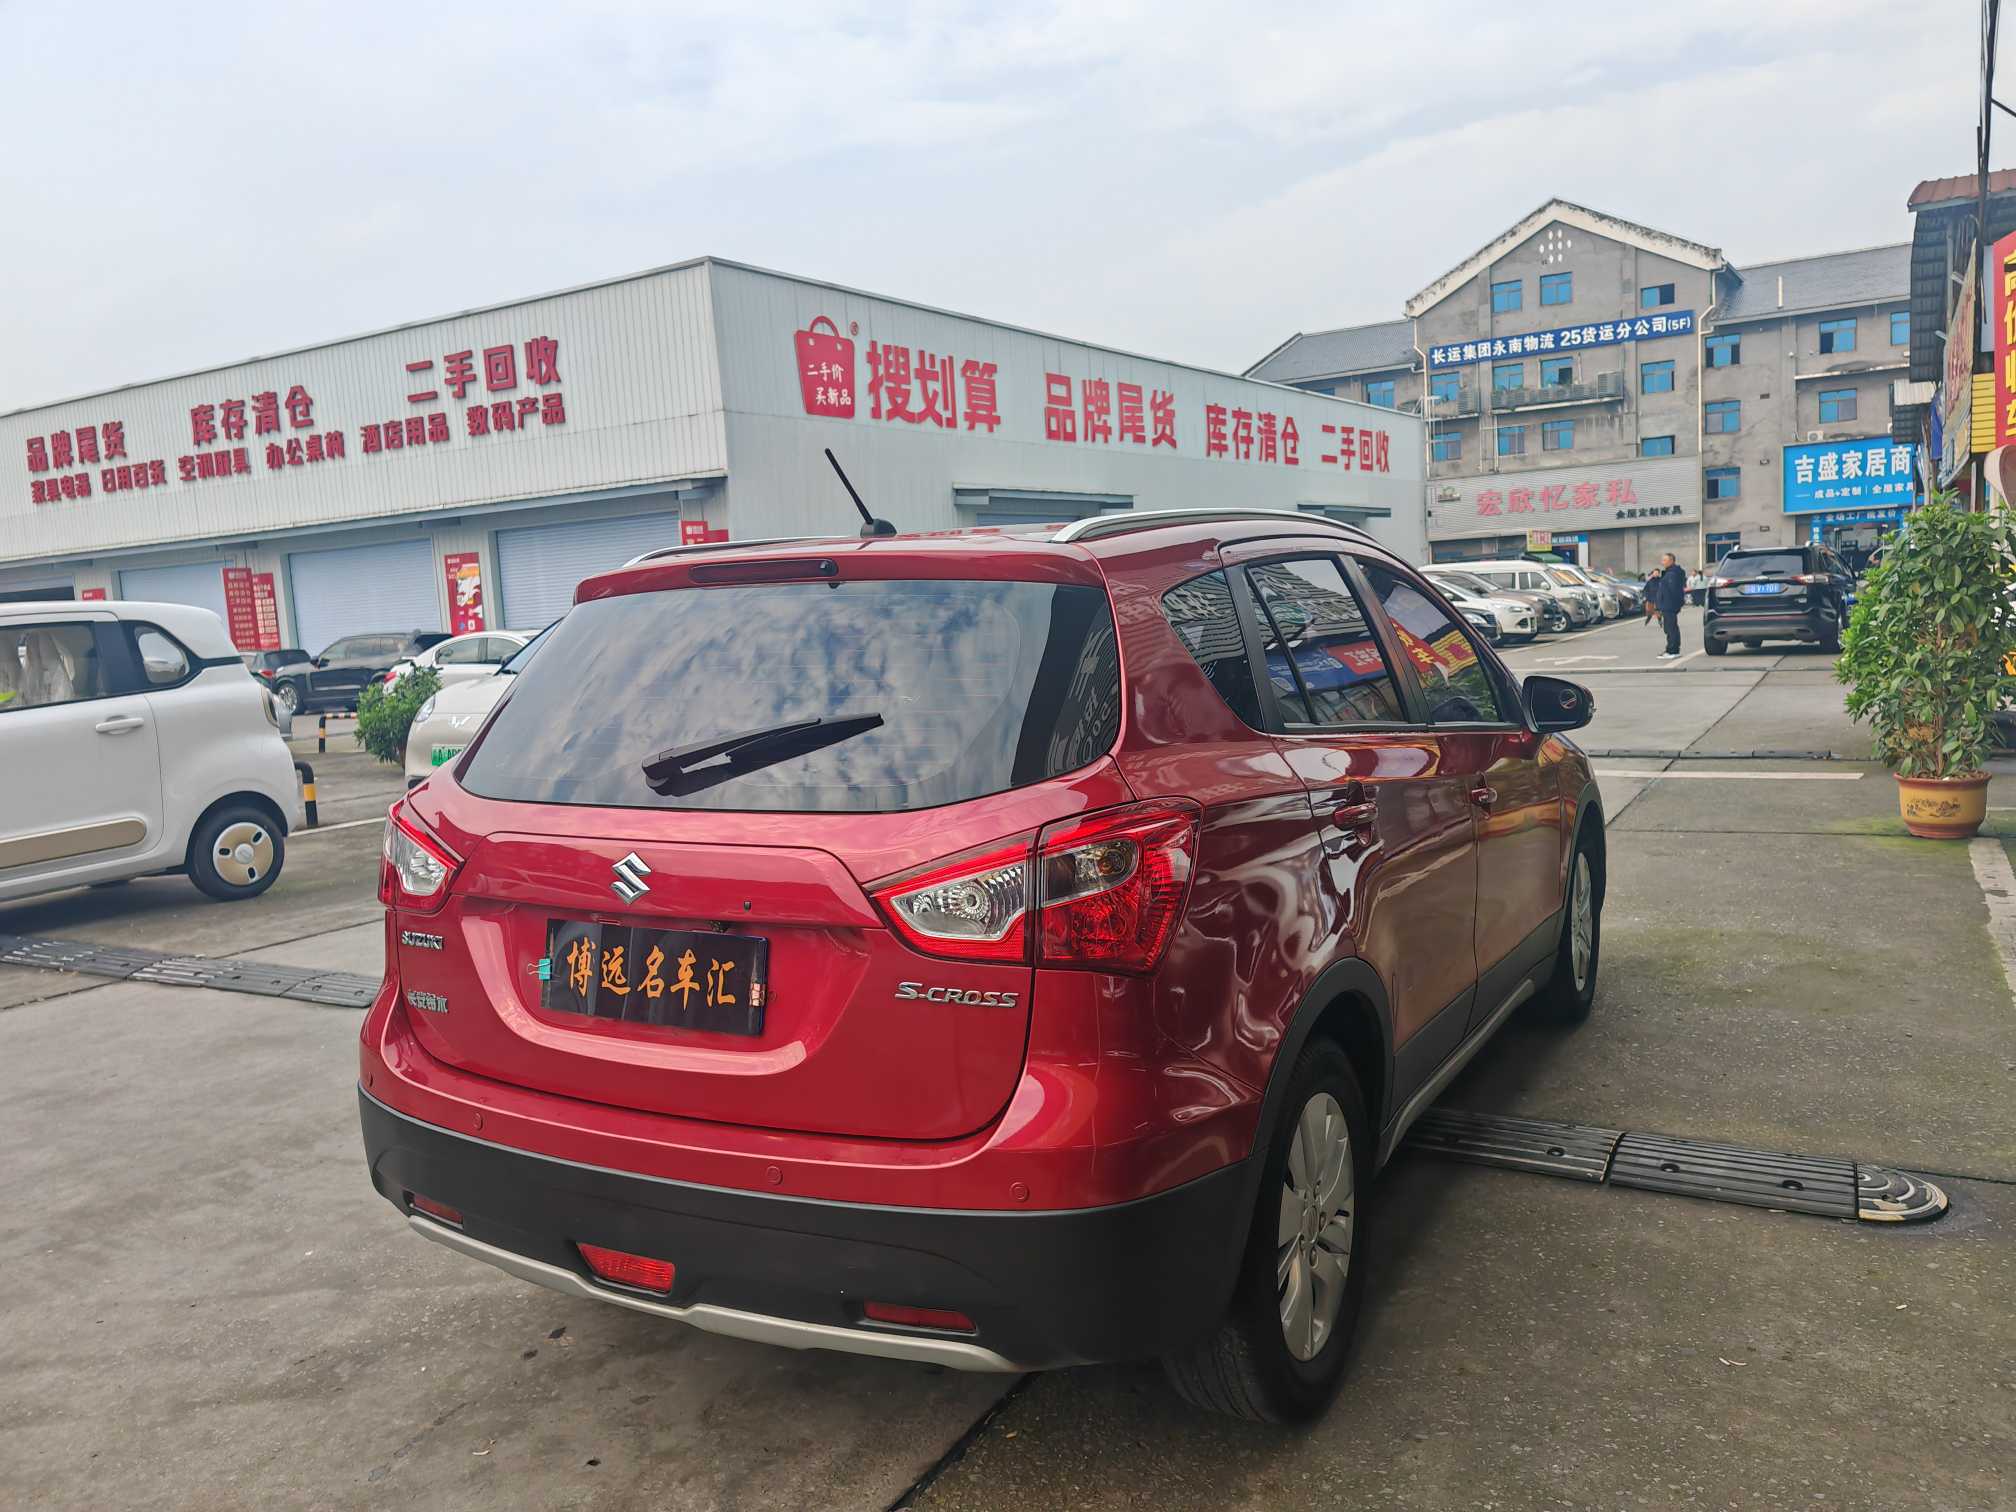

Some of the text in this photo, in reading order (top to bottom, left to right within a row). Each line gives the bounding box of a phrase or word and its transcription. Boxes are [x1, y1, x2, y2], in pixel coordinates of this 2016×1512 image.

[1431, 333, 1555, 365] 长运集团永南物流
[807, 363, 844, 383] 二手价
[26, 336, 561, 473] 品牌尾货 库存清仓 二手回收
[815, 387, 852, 408] 买新品
[866, 340, 1391, 473] 搜划算 品牌尾货 库存清仓 二手回收
[360, 412, 449, 454] 酒店用品
[466, 392, 565, 437] 数码产品
[1794, 445, 1912, 484] 吉盛家居商
[401, 930, 443, 950] SUZUKI
[566, 936, 737, 1011] 博远名车汇
[894, 981, 1020, 1008] S-CROSS
